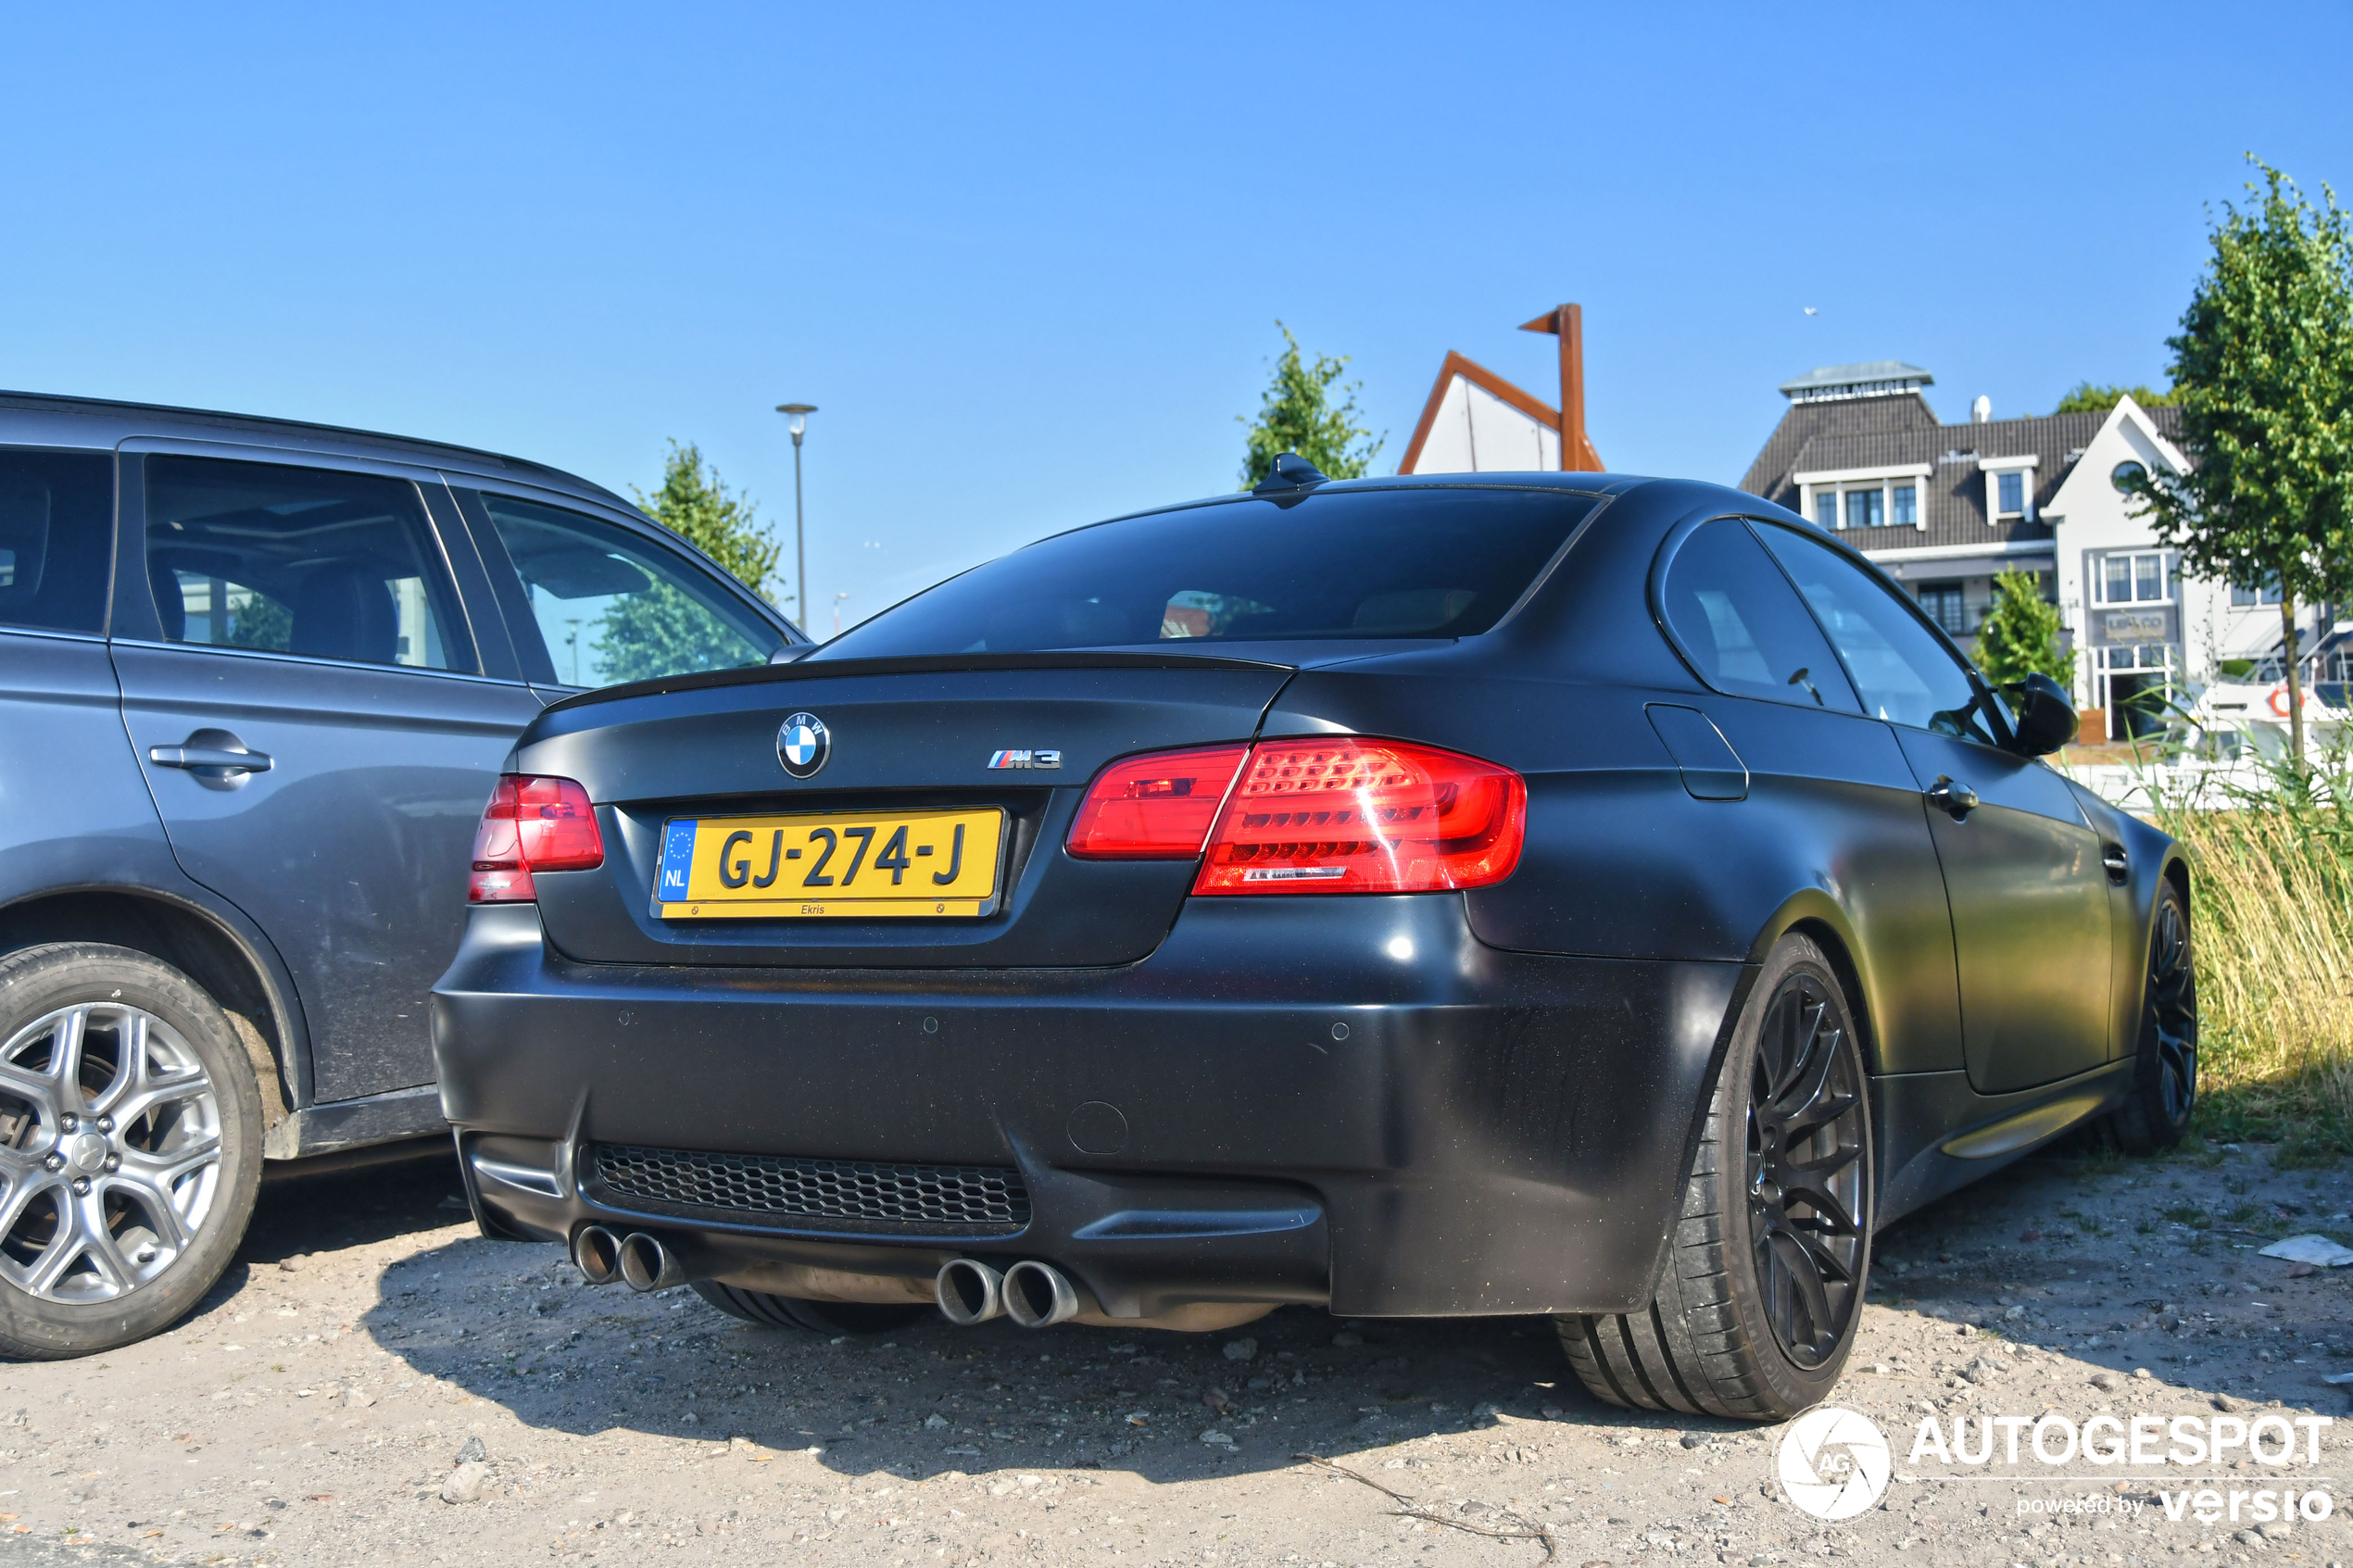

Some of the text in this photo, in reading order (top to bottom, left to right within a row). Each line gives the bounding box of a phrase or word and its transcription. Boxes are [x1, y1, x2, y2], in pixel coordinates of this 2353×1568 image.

[781, 715, 823, 736] BMW
[719, 823, 966, 888] GJ-274-J
[664, 869, 686, 887] NL
[800, 904, 825, 915] Ekris
